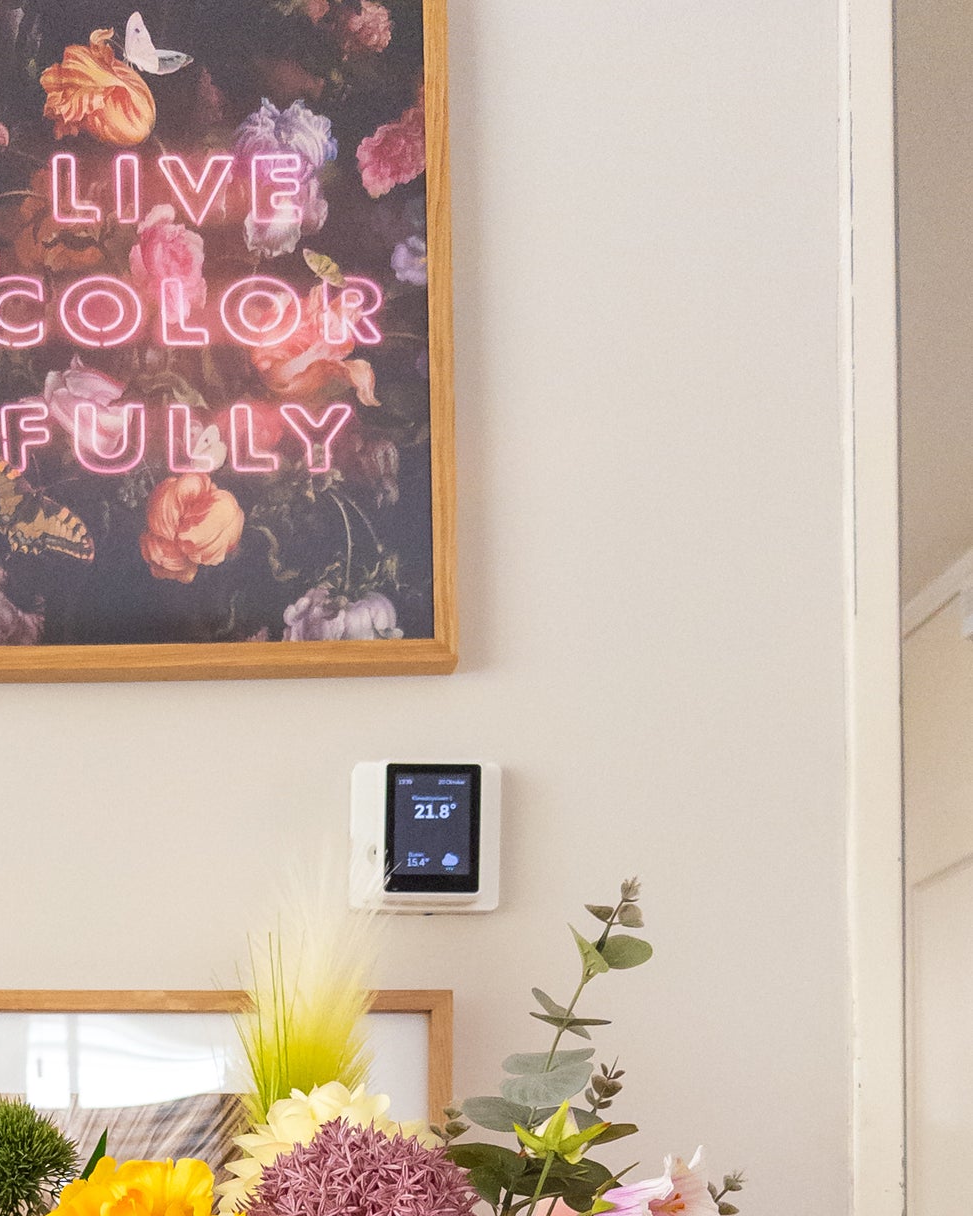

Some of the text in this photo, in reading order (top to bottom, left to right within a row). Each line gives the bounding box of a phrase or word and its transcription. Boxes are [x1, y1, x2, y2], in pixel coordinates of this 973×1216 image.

[50, 153, 304, 226] LIVE
[0, 401, 352, 475] FULLY
[414, 803, 457, 819] 21.8°
